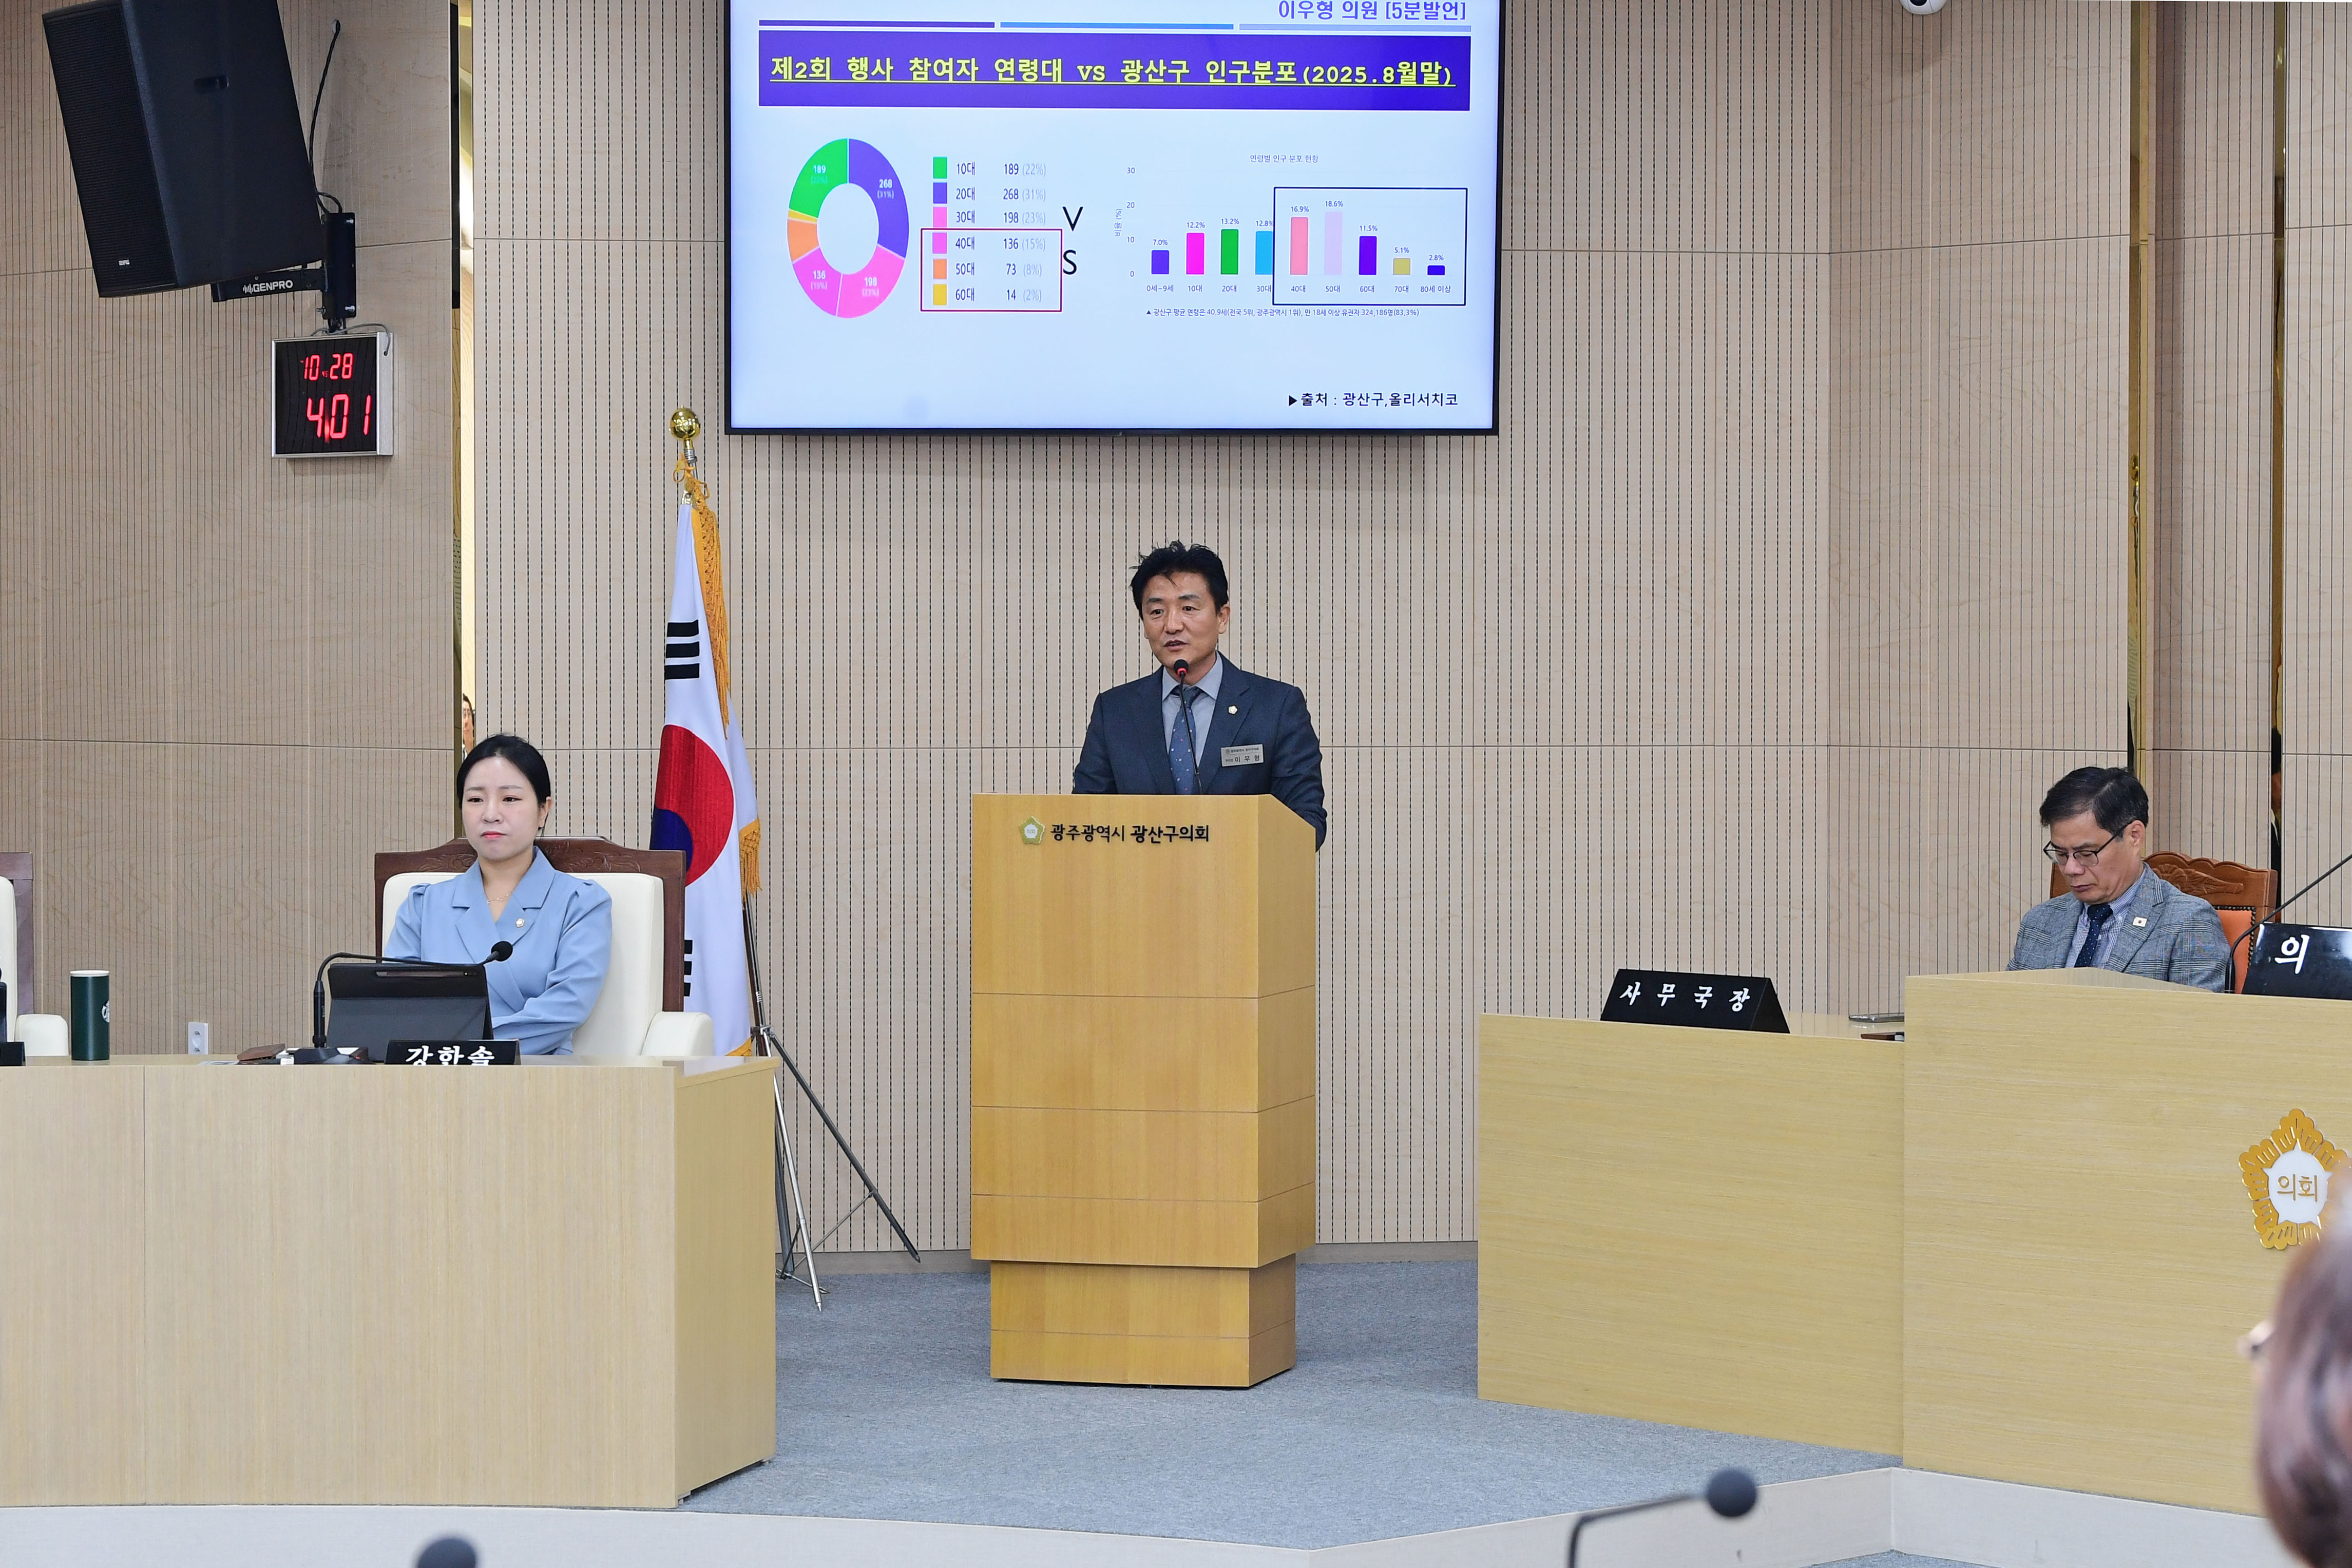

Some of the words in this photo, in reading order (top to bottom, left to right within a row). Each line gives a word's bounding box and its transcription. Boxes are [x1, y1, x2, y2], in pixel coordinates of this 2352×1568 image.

[1278, 0, 1333, 20] 이우형
[1342, 1, 1378, 20] 의원
[1386, 1, 1466, 21] [5분발언]
[771, 56, 831, 80] 제2회
[847, 58, 894, 81] 행사
[909, 58, 979, 82] 참여자
[994, 58, 1063, 82] 연령대
[1077, 65, 1105, 82] vs
[1121, 60, 1190, 83] 광산구
[1273, 154, 1287, 163] 인구
[1289, 155, 1303, 163] 분포
[813, 164, 826, 174] 189
[957, 161, 975, 176] 10대
[1004, 163, 1019, 175] 189
[1022, 163, 1046, 177] (22%)
[955, 186, 975, 201] 20대
[1003, 188, 1019, 200] 268
[1022, 188, 1046, 202] (31%)
[956, 209, 975, 224] 30대
[1004, 212, 1019, 223] 198
[1022, 212, 1046, 226] (23%)
[955, 236, 975, 251] 40대
[1003, 238, 1019, 250] 136
[1022, 238, 1046, 252] (15%)
[955, 261, 975, 276] 50대
[1006, 263, 1017, 276] 73
[1023, 263, 1042, 277] (8%)
[253, 279, 294, 293] GENPRO
[1146, 284, 1174, 292] 0세~9세
[1188, 284, 1202, 292] 10대
[1221, 284, 1237, 293] 20대
[1256, 284, 1272, 293] 30대
[1290, 284, 1306, 293] 40대
[1325, 284, 1341, 293] 50대
[1394, 285, 1409, 293] 70대
[1420, 285, 1436, 293] 80세
[1437, 285, 1451, 293] 이상
[955, 287, 974, 302] 60대
[1007, 289, 1016, 301] 14
[1023, 289, 1042, 303] (2%)
[1301, 392, 1327, 407] 출처
[1342, 392, 1458, 408] 광산구,올리서치코
[1050, 824, 1125, 843] 광주광역시
[1130, 824, 1209, 844] 광산구의회
[2274, 933, 2310, 975] 의
[2277, 1174, 2318, 1202] 의회
